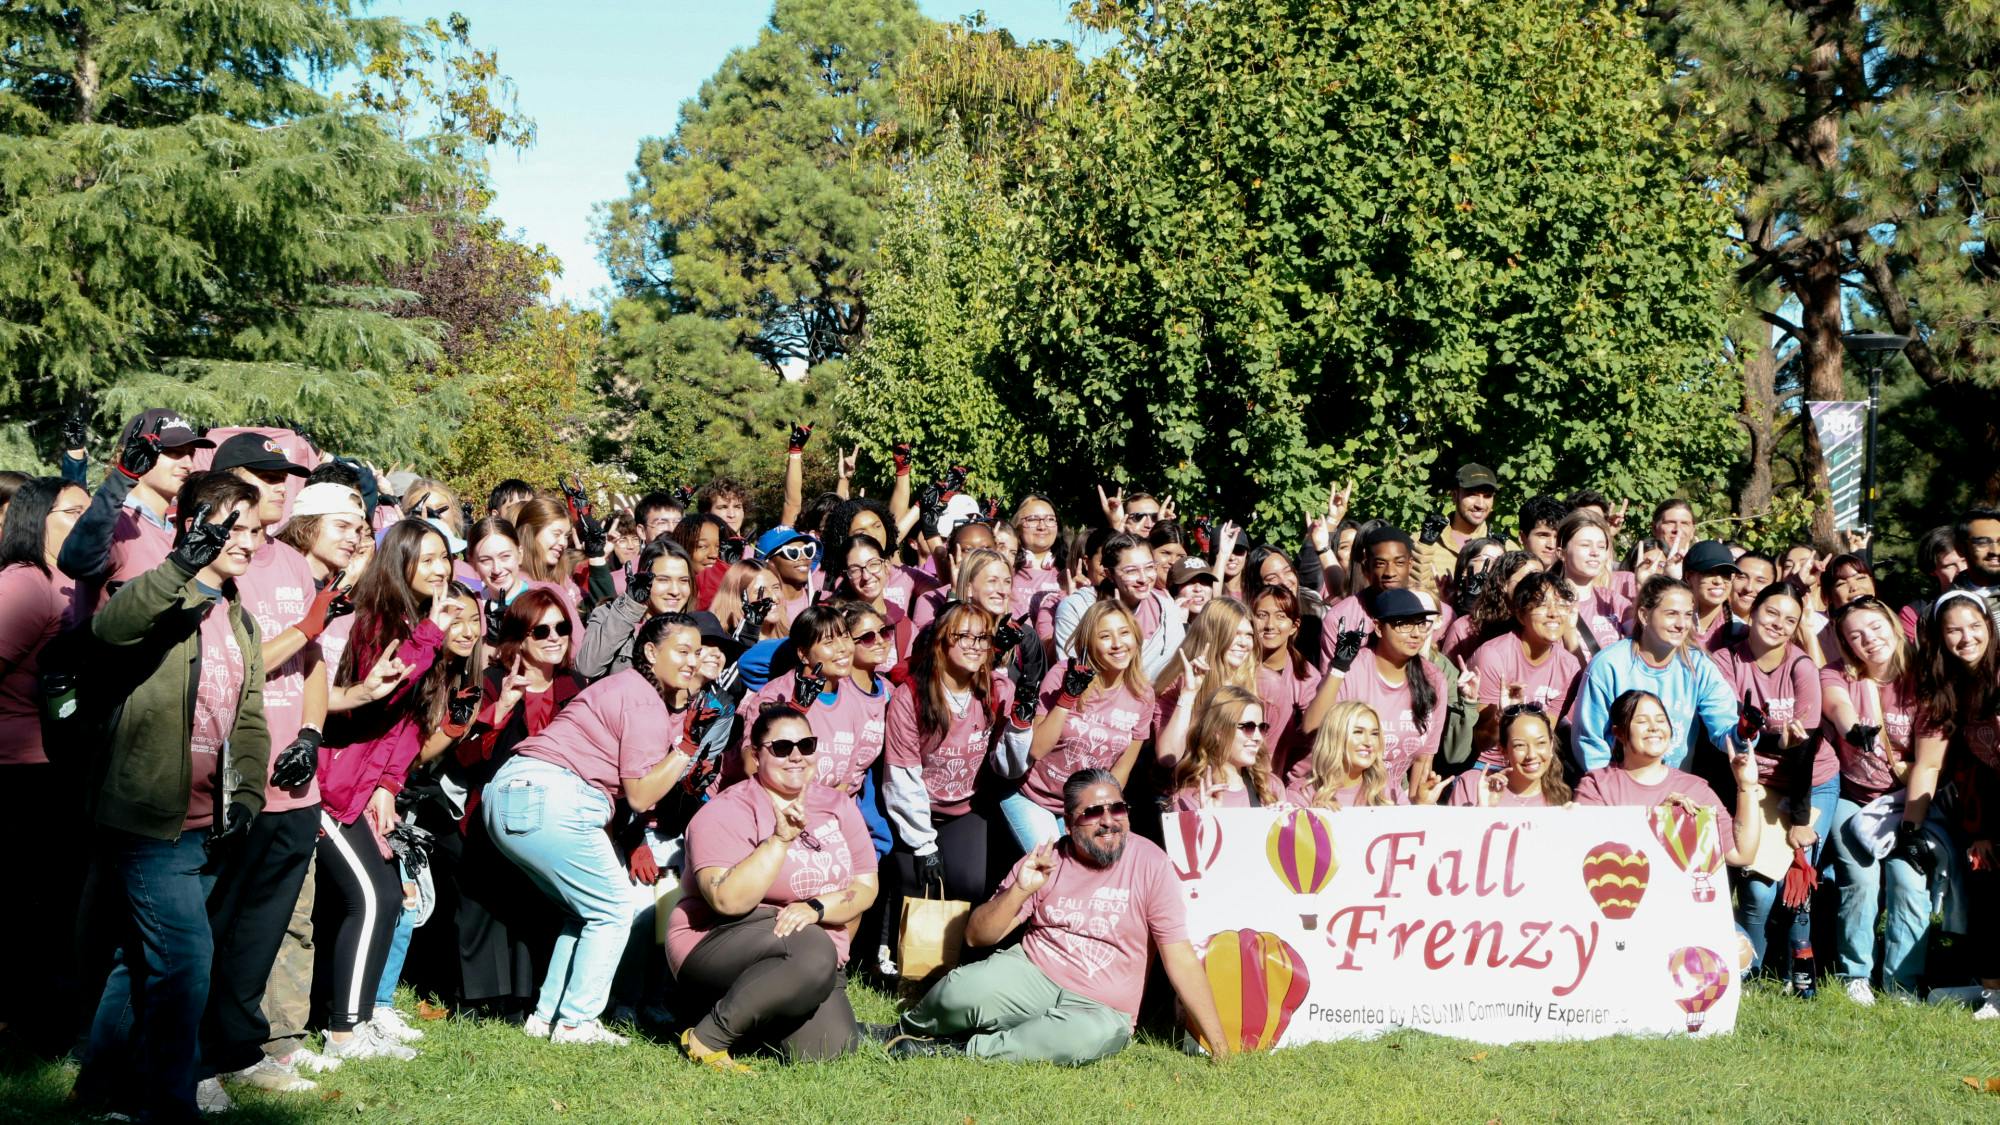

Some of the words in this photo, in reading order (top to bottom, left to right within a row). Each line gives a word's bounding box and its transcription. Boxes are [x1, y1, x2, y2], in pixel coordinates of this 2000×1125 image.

[938, 747, 963, 757] FALL
[1365, 821, 1525, 899] Fall
[1057, 896, 1082, 911] FALL
[1088, 898, 1129, 913] FRENZY
[1326, 905, 1599, 997] Frenzy
[1309, 1003, 1384, 1024] Presented
[1468, 1000, 1543, 1024] Community
